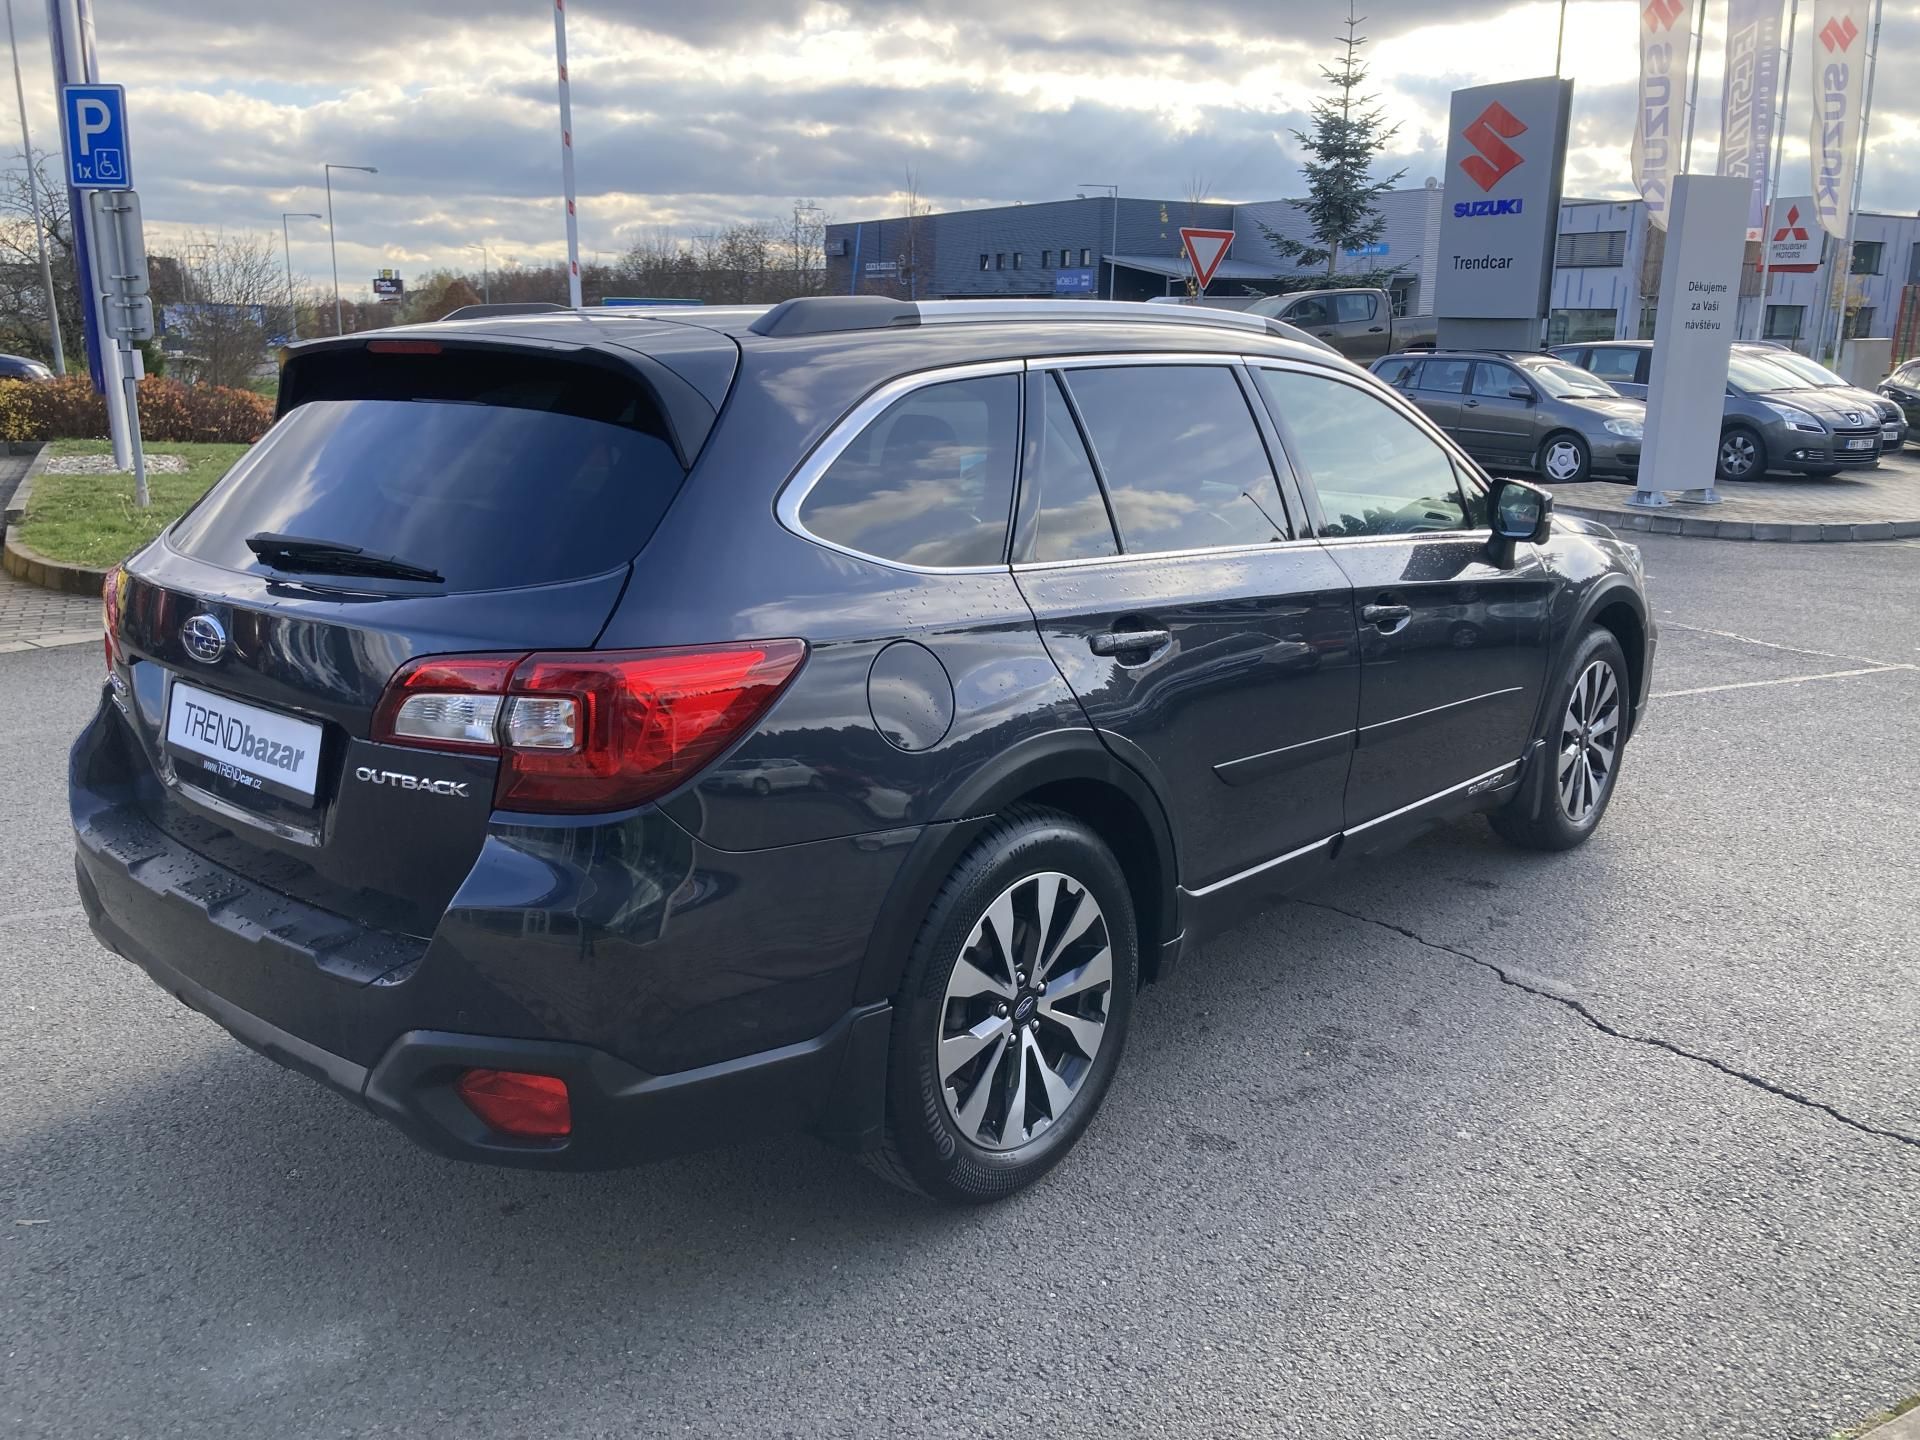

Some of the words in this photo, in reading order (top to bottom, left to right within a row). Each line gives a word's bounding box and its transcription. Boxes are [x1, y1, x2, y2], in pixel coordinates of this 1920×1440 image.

[76, 98, 111, 156] P
[77, 162, 92, 179] 1x
[1454, 199, 1523, 218] SUZUKI
[1453, 254, 1513, 270] Trendcar
[1688, 281, 1727, 294] Děkujeme
[1691, 302, 1701, 311] za
[1685, 319, 1721, 330] návštěvu
[184, 701, 304, 772] TRENDbazar
[203, 760, 262, 790] www.TRENDcar.cz
[355, 766, 469, 797] OUTBACK
